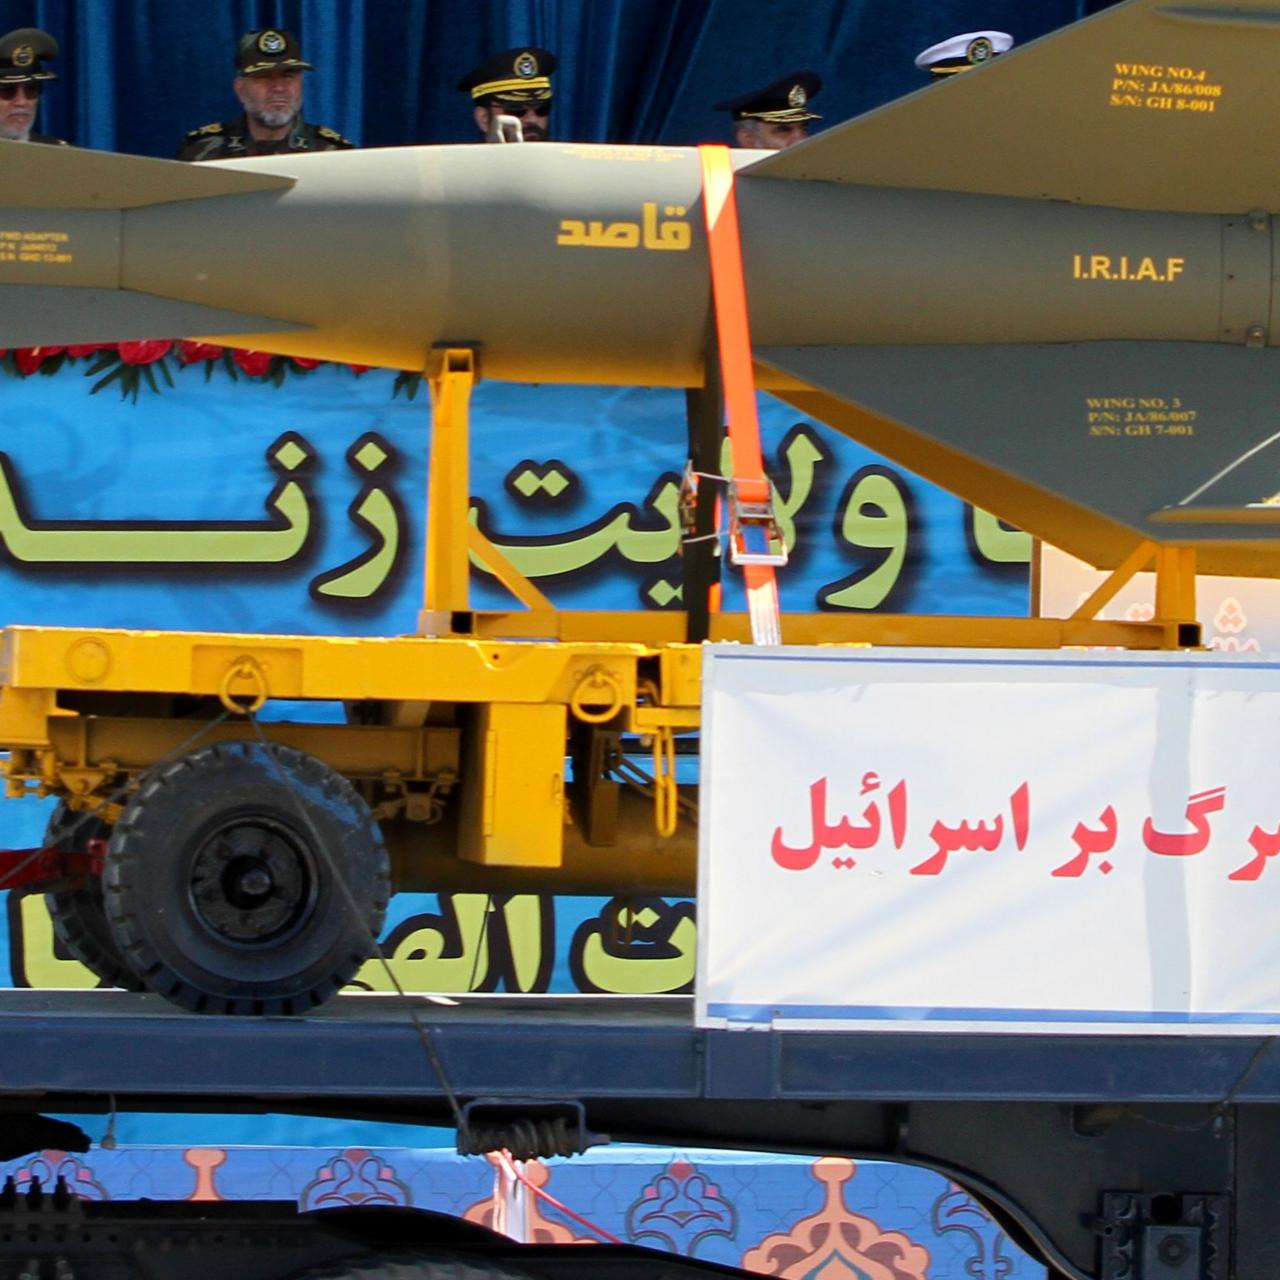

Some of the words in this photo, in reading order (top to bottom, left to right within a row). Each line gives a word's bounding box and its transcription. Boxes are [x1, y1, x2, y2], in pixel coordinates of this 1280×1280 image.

[1114, 63, 1163, 77] WING
[1167, 66, 1206, 81] NO.4
[1146, 97, 1173, 109] GH
[557, 202, 692, 251] قاصد
[1073, 255, 1185, 283] I.R.I.A.F
[1086, 398, 1136, 409] WING
[770, 770, 1031, 876] اسرائیل
[1050, 803, 1118, 879] بر
